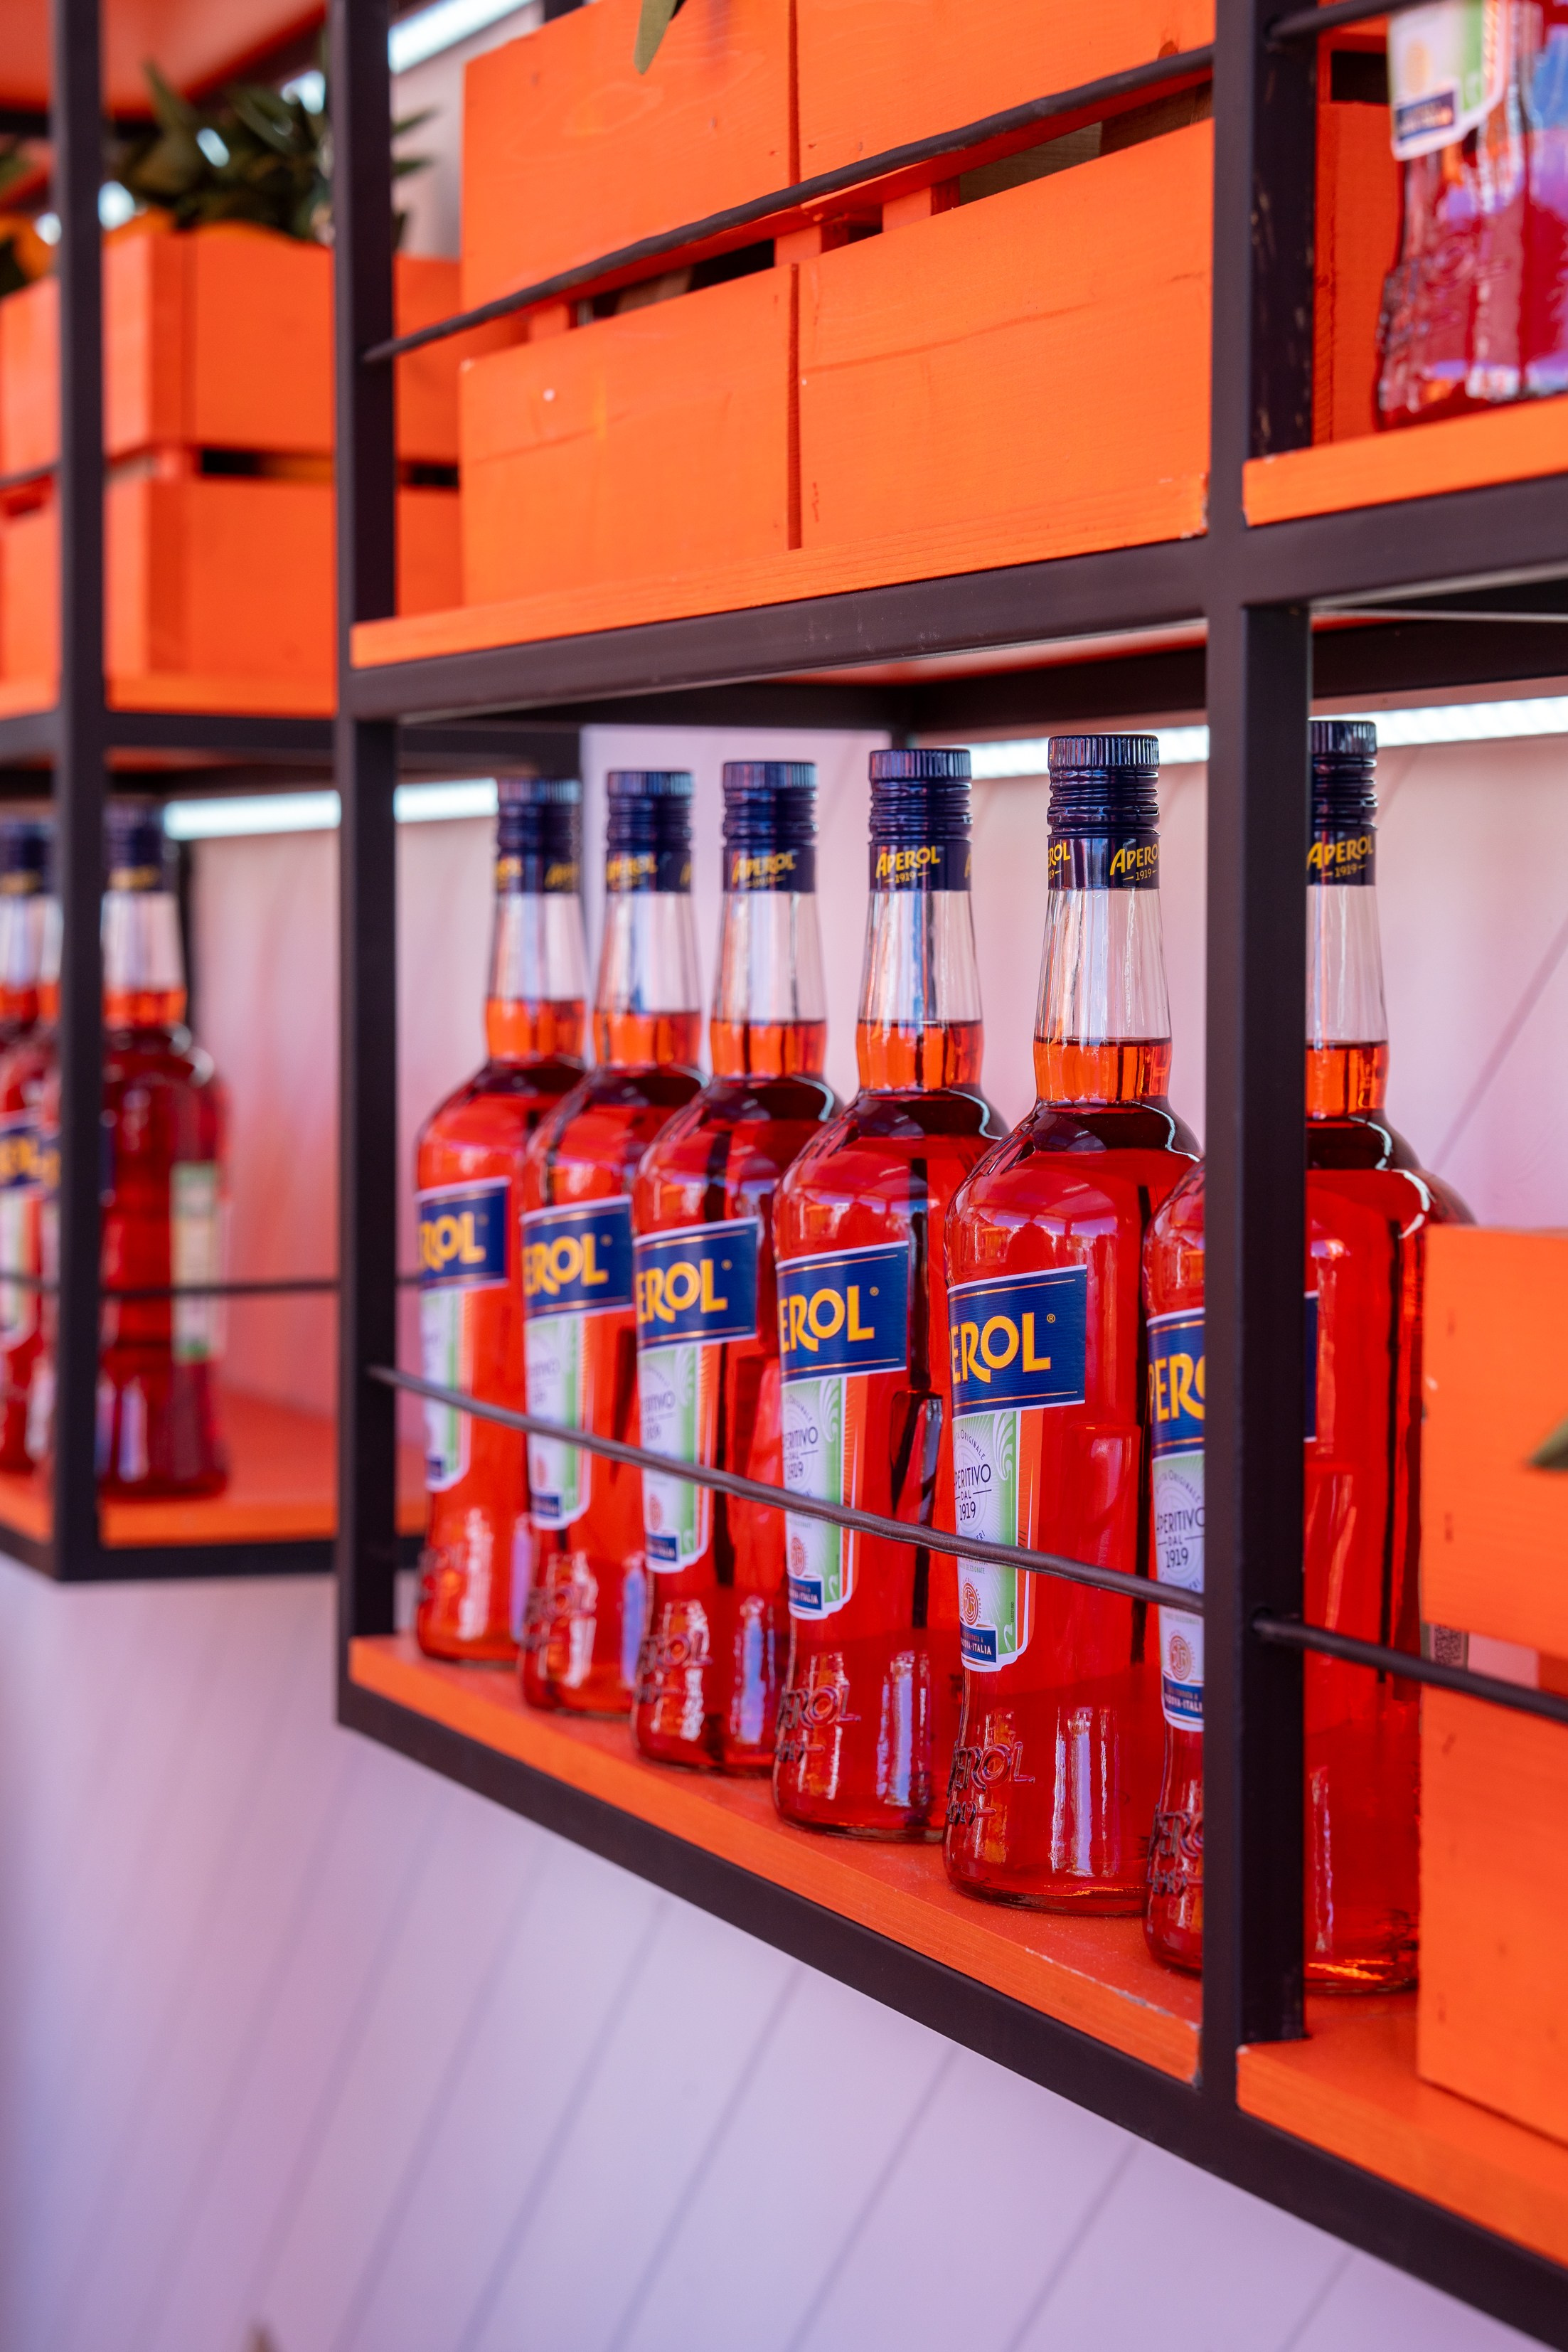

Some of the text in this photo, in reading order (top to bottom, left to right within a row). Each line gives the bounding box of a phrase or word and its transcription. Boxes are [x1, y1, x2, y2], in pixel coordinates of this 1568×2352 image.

[875, 846, 941, 878] APEROL
[1047, 842, 1071, 868] ROL
[1109, 843, 1159, 876] APERO
[1306, 835, 1374, 871] APEROL
[895, 871, 917, 884] 1919
[1136, 868, 1152, 881] 1919
[1335, 863, 1357, 878] 1919
[420, 1210, 486, 1273] ROL
[636, 1258, 728, 1325] EROL
[779, 1284, 875, 1354] EROL
[949, 1311, 1051, 1385] EROL
[960, 1429, 986, 1461] ORIGINALE
[959, 1501, 976, 1521] 1919
[961, 1489, 972, 1501] DAL
[1166, 1548, 1188, 1568] 1919
